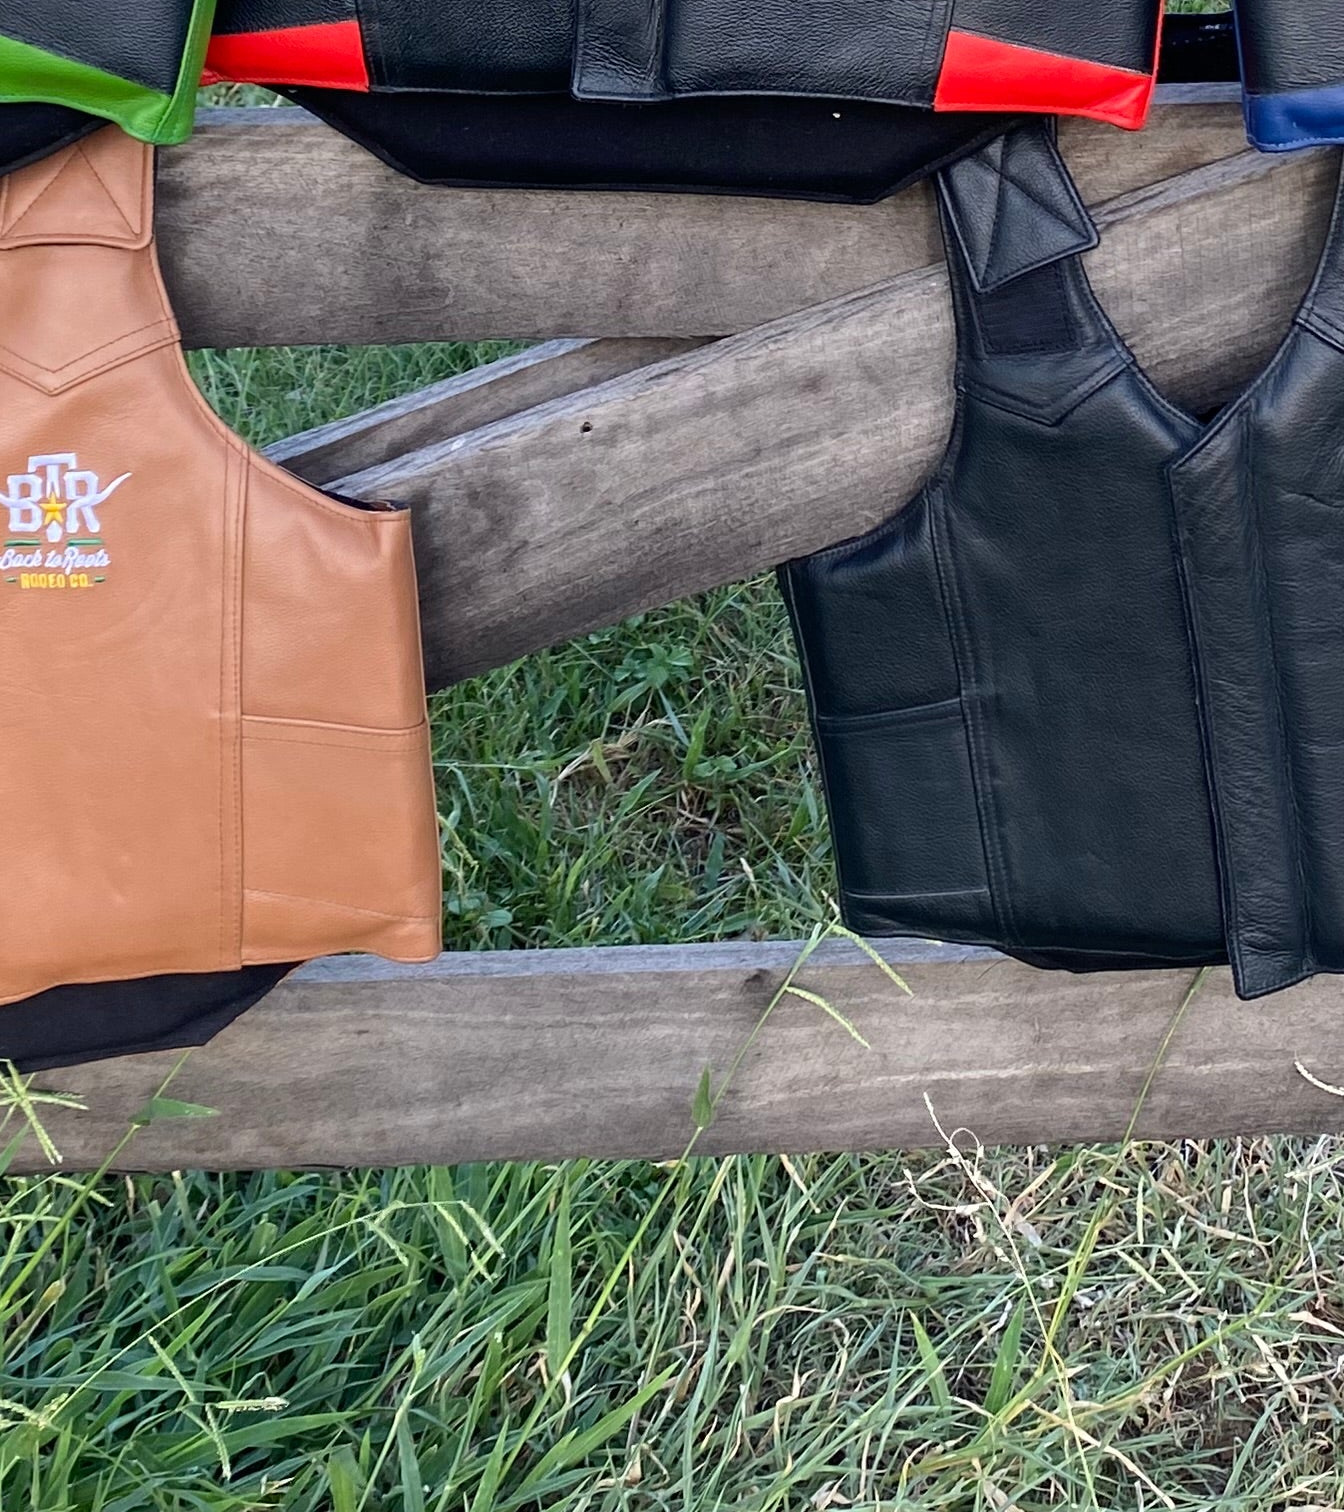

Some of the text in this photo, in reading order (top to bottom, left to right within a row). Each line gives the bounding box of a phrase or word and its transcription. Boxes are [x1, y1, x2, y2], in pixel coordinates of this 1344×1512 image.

[6, 452, 100, 543] BTR
[44, 550, 64, 568] to
[61, 546, 111, 575] Roots
[20, 573, 66, 589] RODEO
